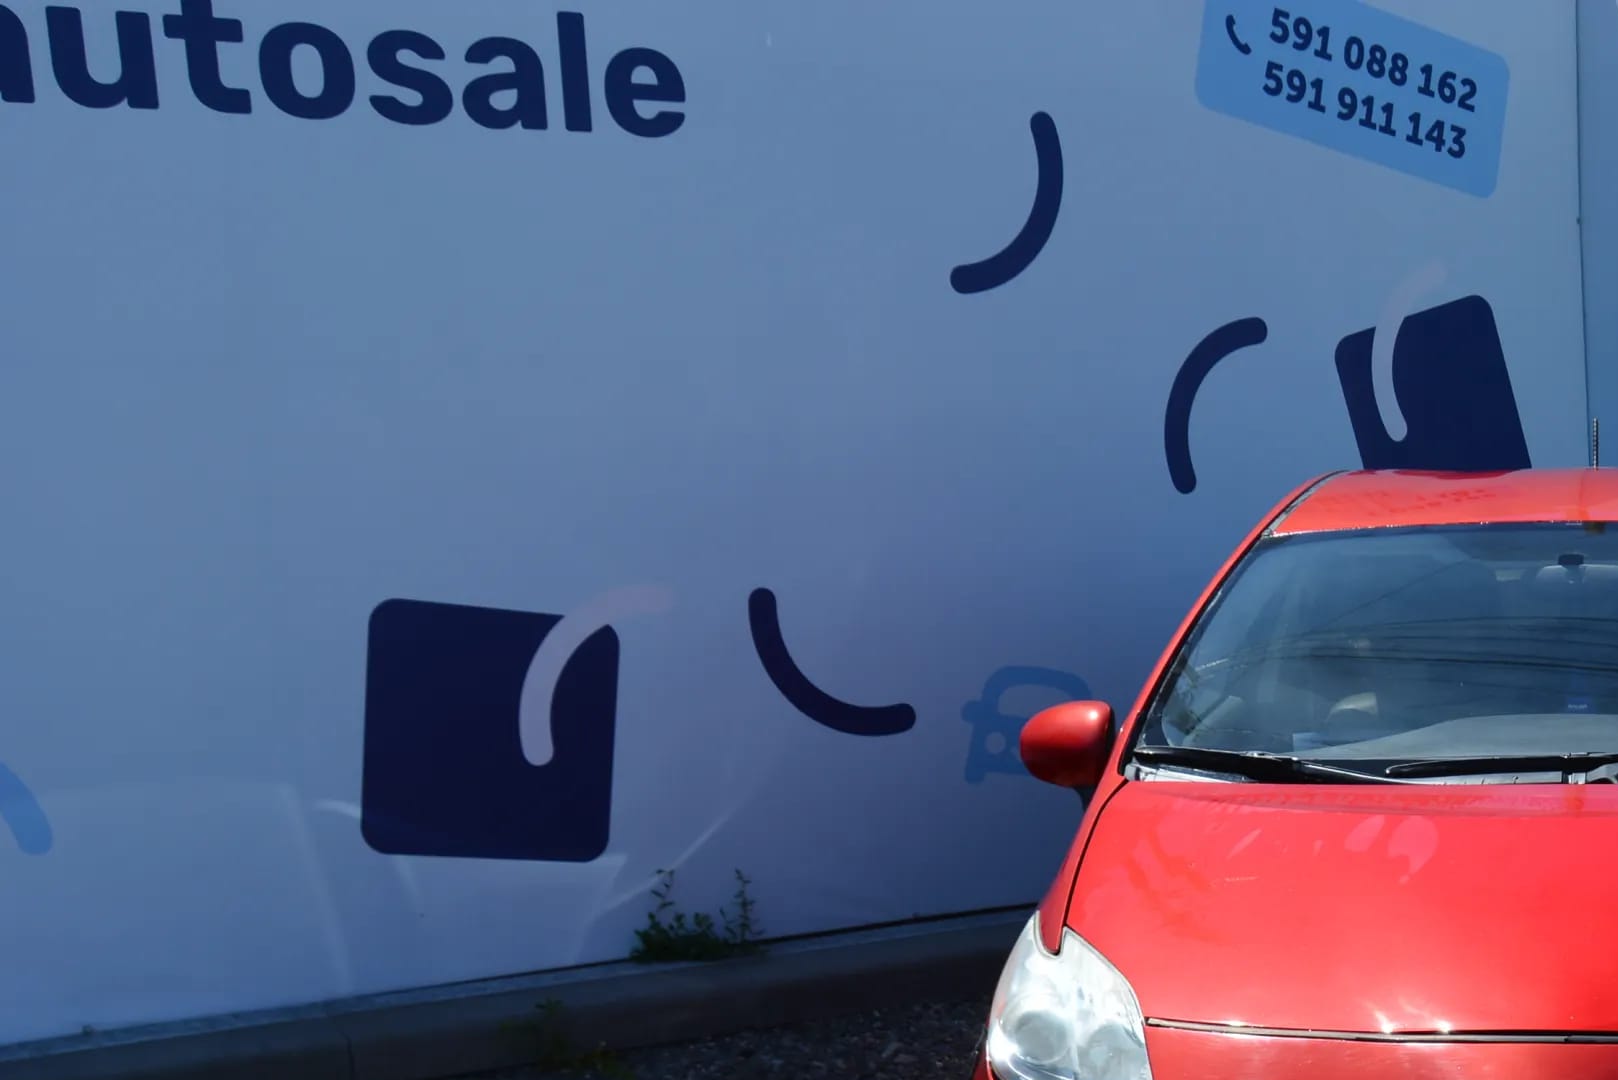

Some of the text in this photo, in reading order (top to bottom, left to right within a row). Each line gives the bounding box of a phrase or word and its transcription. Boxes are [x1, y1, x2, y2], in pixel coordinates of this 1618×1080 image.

[1262, 60, 1467, 159] 591 911 143
[1269, 7, 1478, 113] 591 088 162
